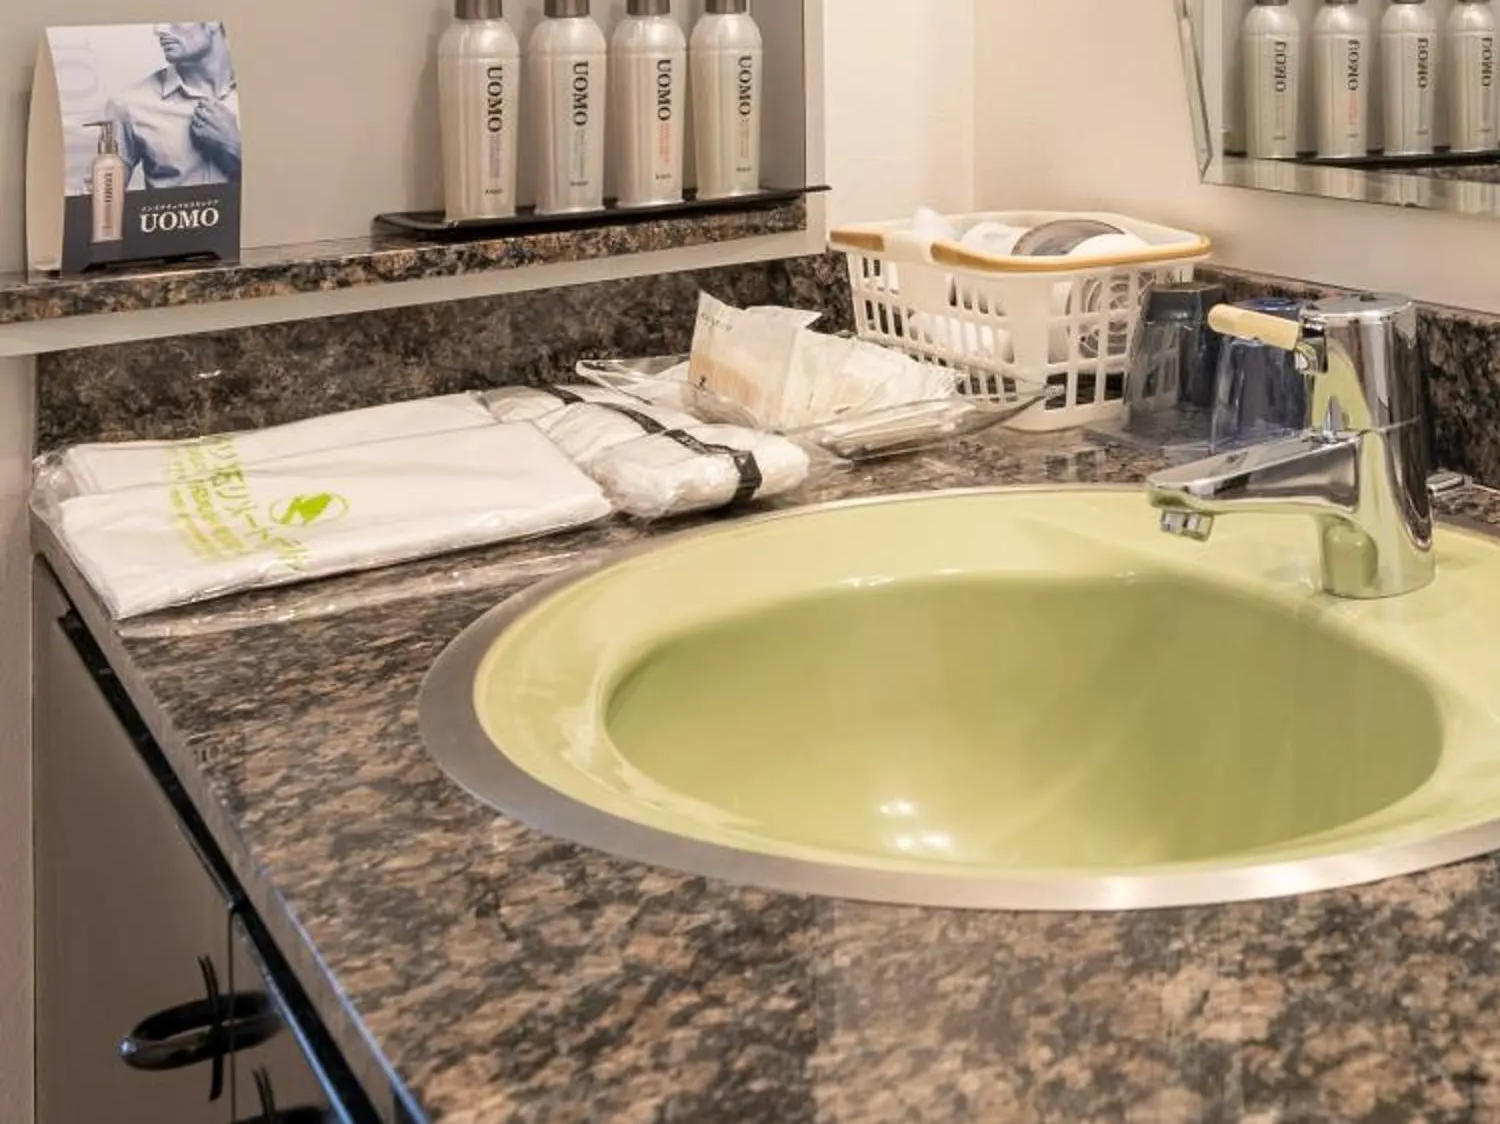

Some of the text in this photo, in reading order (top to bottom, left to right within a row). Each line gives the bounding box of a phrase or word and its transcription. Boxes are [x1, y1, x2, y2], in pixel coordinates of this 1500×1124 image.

[486, 65, 503, 133] UOMO
[573, 60, 589, 127] UOMO
[656, 59, 672, 121] UOMO
[738, 55, 752, 116] UOMO
[140, 207, 219, 232] UOMO
